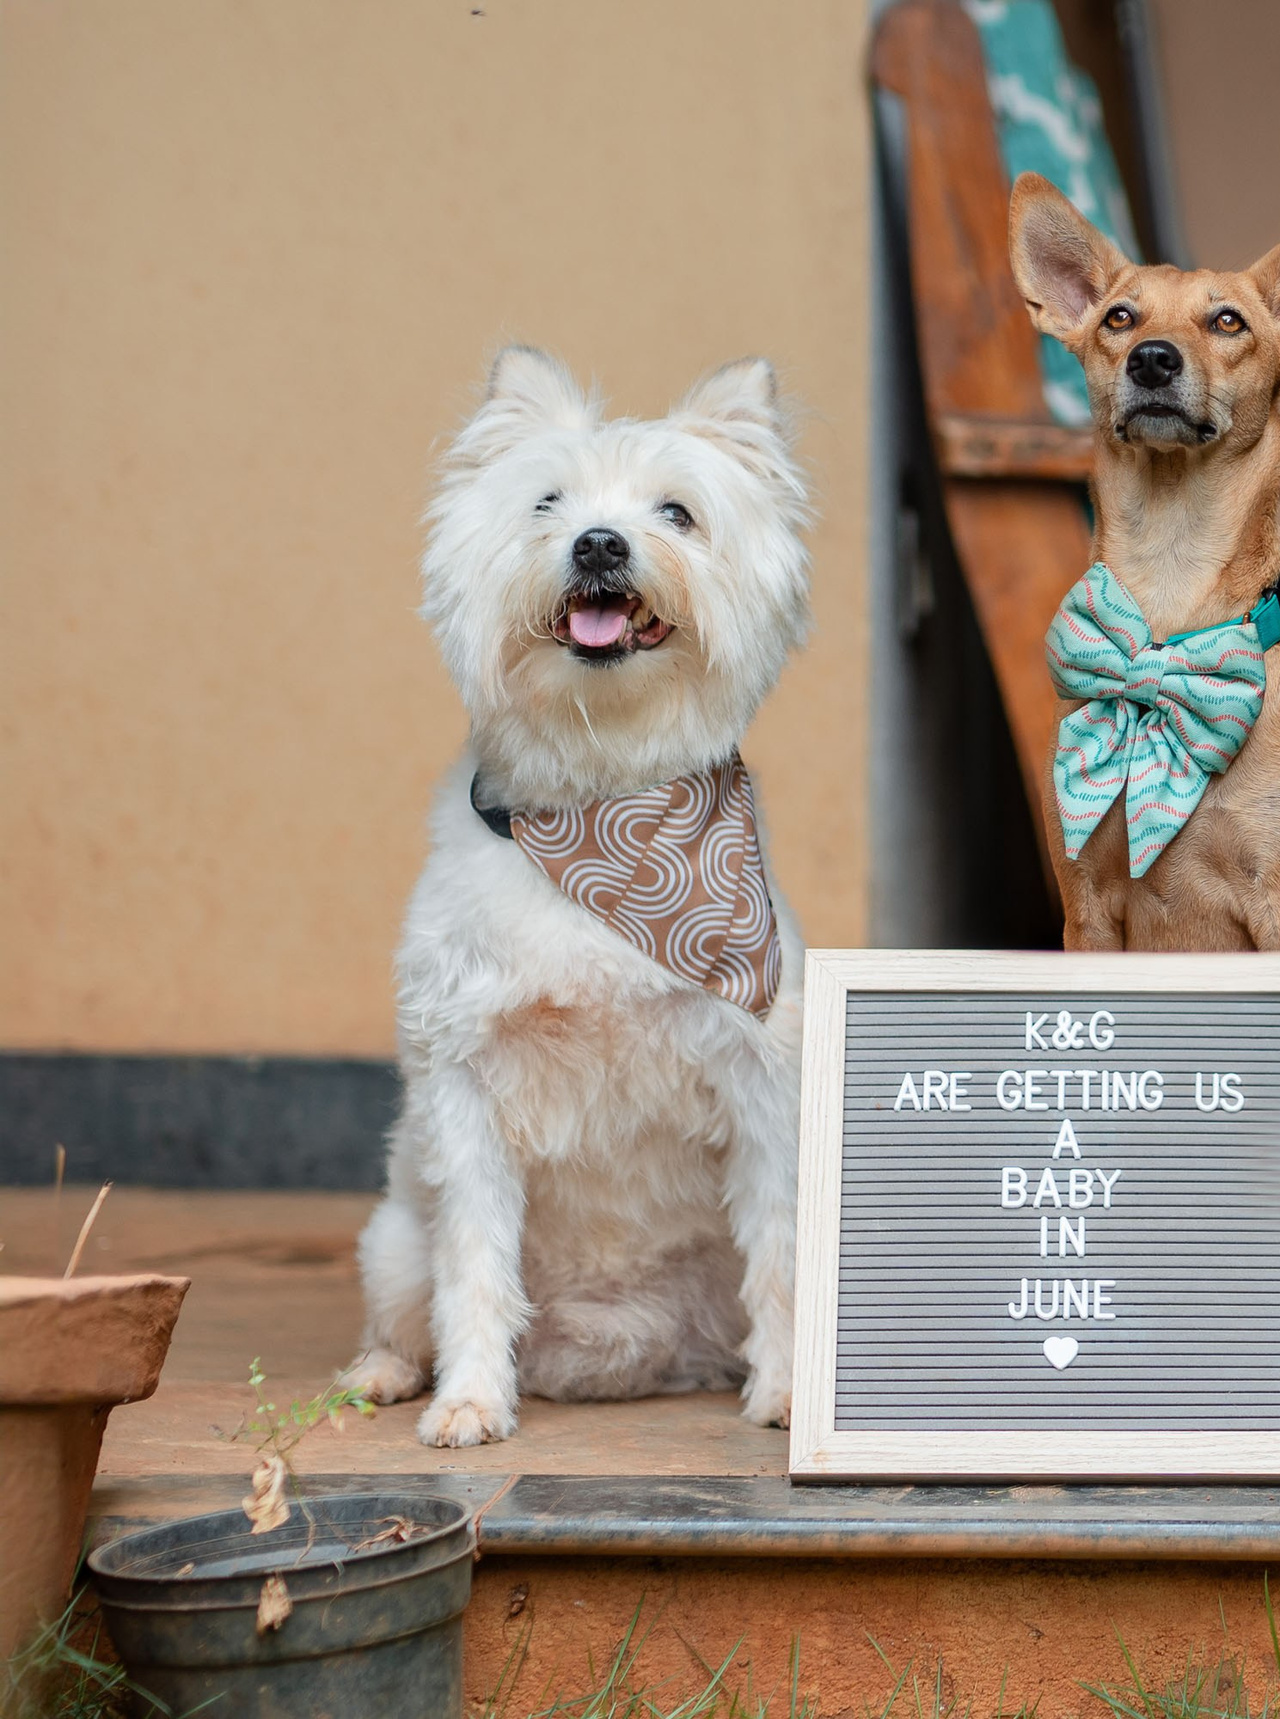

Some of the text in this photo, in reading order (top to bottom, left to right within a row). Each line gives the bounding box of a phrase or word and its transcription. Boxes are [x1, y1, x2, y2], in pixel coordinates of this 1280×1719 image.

[1024, 1010, 1115, 1051] K&G
[893, 1070, 1245, 1112] ARE GETTING US
[1052, 1118, 1082, 1160] A
[1001, 1166, 1122, 1209] BABY
[1039, 1215, 1086, 1258] IN
[1007, 1277, 1117, 1320] JUNE
